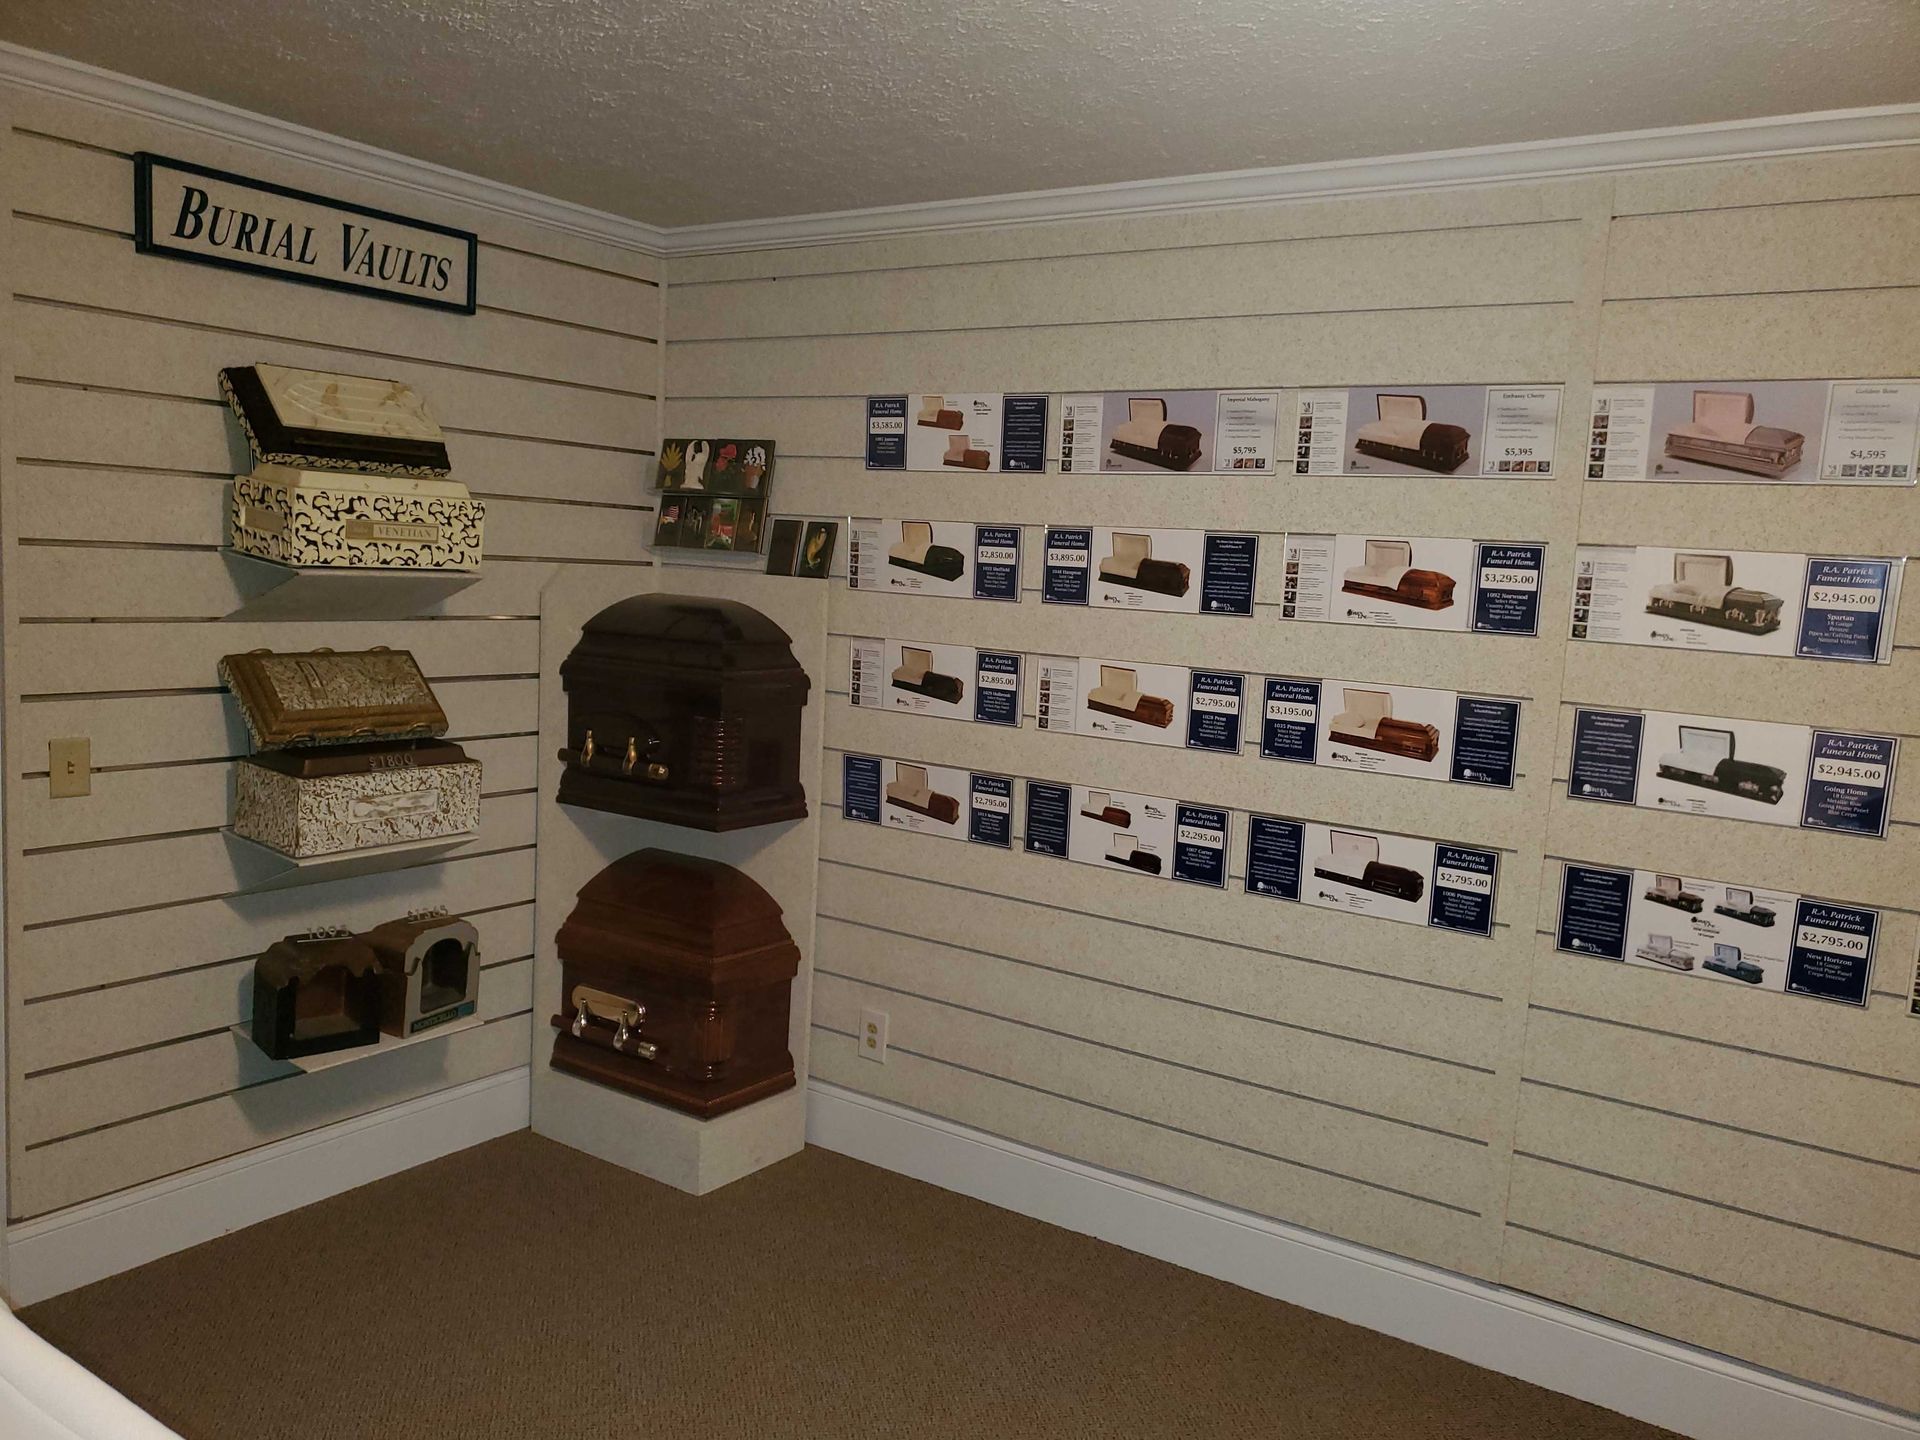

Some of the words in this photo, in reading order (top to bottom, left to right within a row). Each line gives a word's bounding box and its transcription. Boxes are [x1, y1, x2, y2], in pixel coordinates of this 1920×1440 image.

[170, 186, 318, 265] BURIAL
[342, 223, 452, 292] VAULTS
[1505, 448, 1532, 456] $5,395
[1850, 450, 1886, 460] $4,595
[980, 551, 1013, 559] $2,850.00
[1050, 554, 1085, 562] $3,895.00
[1822, 566, 1839, 574] R.A.
[1842, 567, 1874, 575] Patrick
[1485, 573, 1534, 584] $3,295.00
[1816, 575, 1850, 583] Funeral
[1813, 592, 1876, 605] $2,945.00
[981, 675, 1014, 685] $2,895.00
[1213, 678, 1233, 686] Patrick
[1195, 697, 1235, 708] $2,795.00
[1270, 706, 1312, 717] $3,195.00
[1847, 741, 1880, 751] Patrick
[1821, 747, 1855, 757] Funeral
[1857, 752, 1883, 760] Home
[369, 752, 414, 768] $1800
[1818, 764, 1881, 780] $2,945.00
[1824, 785, 1845, 794] Going
[1847, 787, 1868, 796] Home
[975, 797, 1007, 808] $2,795.00
[1181, 830, 1220, 843] $2,295.00
[1447, 851, 1460, 859] R.A.
[1461, 853, 1486, 863] Patrick
[1442, 858, 1468, 867] Funeral
[1469, 863, 1488, 871] Home
[1440, 873, 1487, 888] $2,795.00
[1811, 908, 1828, 917] R.A.
[1830, 911, 1861, 922] Patrick
[1805, 915, 1838, 927] Funeral
[1840, 920, 1865, 931] Home
[1802, 932, 1863, 950] $2,795.00
[1806, 952, 1821, 960] New
[1824, 955, 1852, 966] Horizon
